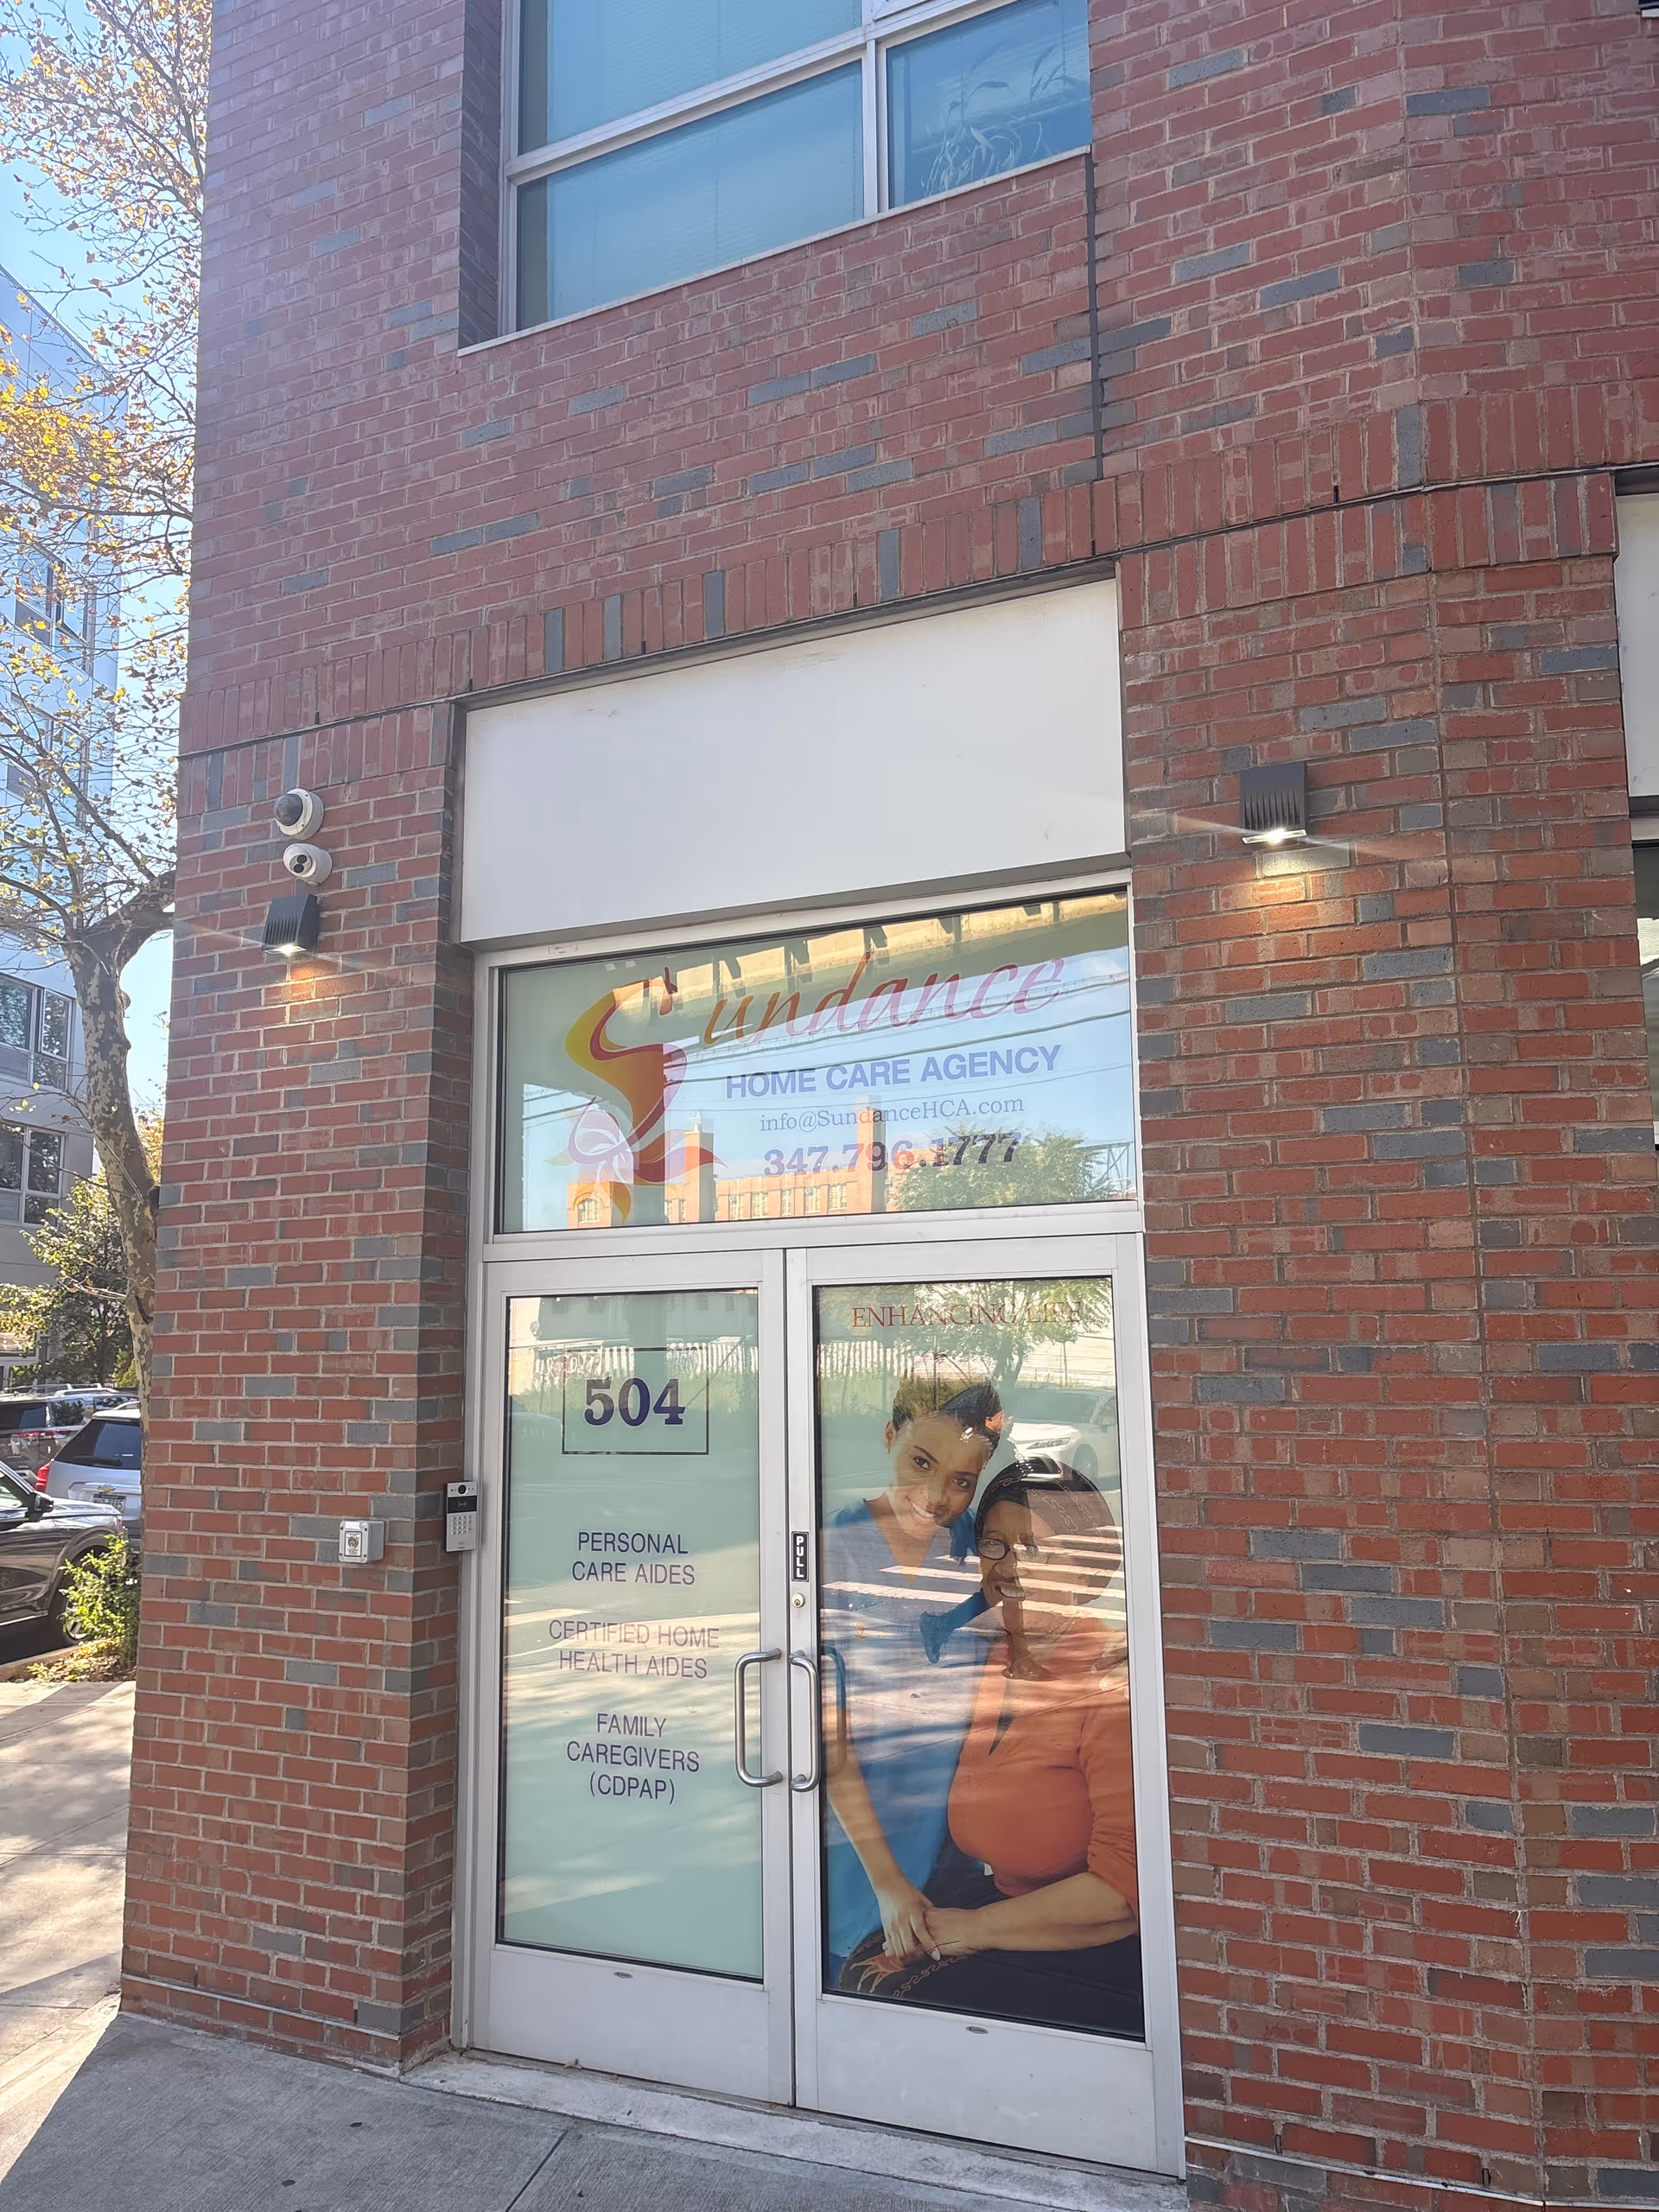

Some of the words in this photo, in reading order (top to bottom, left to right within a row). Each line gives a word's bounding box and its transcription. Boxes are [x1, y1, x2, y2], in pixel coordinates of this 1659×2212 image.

[727, 1068, 816, 1098] HOME
[826, 1059, 911, 1090] CARE
[920, 1045, 1061, 1082] AGENCY
[760, 1098, 1024, 1132] info@SundanceHCA.com
[764, 1132, 1021, 1178] 347.796.1777
[852, 1303, 1016, 1327] ENHANCING
[1026, 1301, 1082, 1324] LIFE
[584, 1376, 686, 1426] 504
[578, 1532, 688, 1554] PERSONAL
[796, 1535, 804, 1578] PULL
[572, 1560, 626, 1582] CARE
[634, 1563, 695, 1585] AIDES
[549, 1619, 650, 1644] CERTIFIED
[658, 1625, 720, 1648] HOME
[559, 1650, 638, 1674] HEALTH
[646, 1656, 707, 1679] AIDES
[597, 1713, 667, 1738] FAMILY
[567, 1741, 700, 1772] CAREGIVERS
[589, 1771, 675, 1804] (CDPAP)
